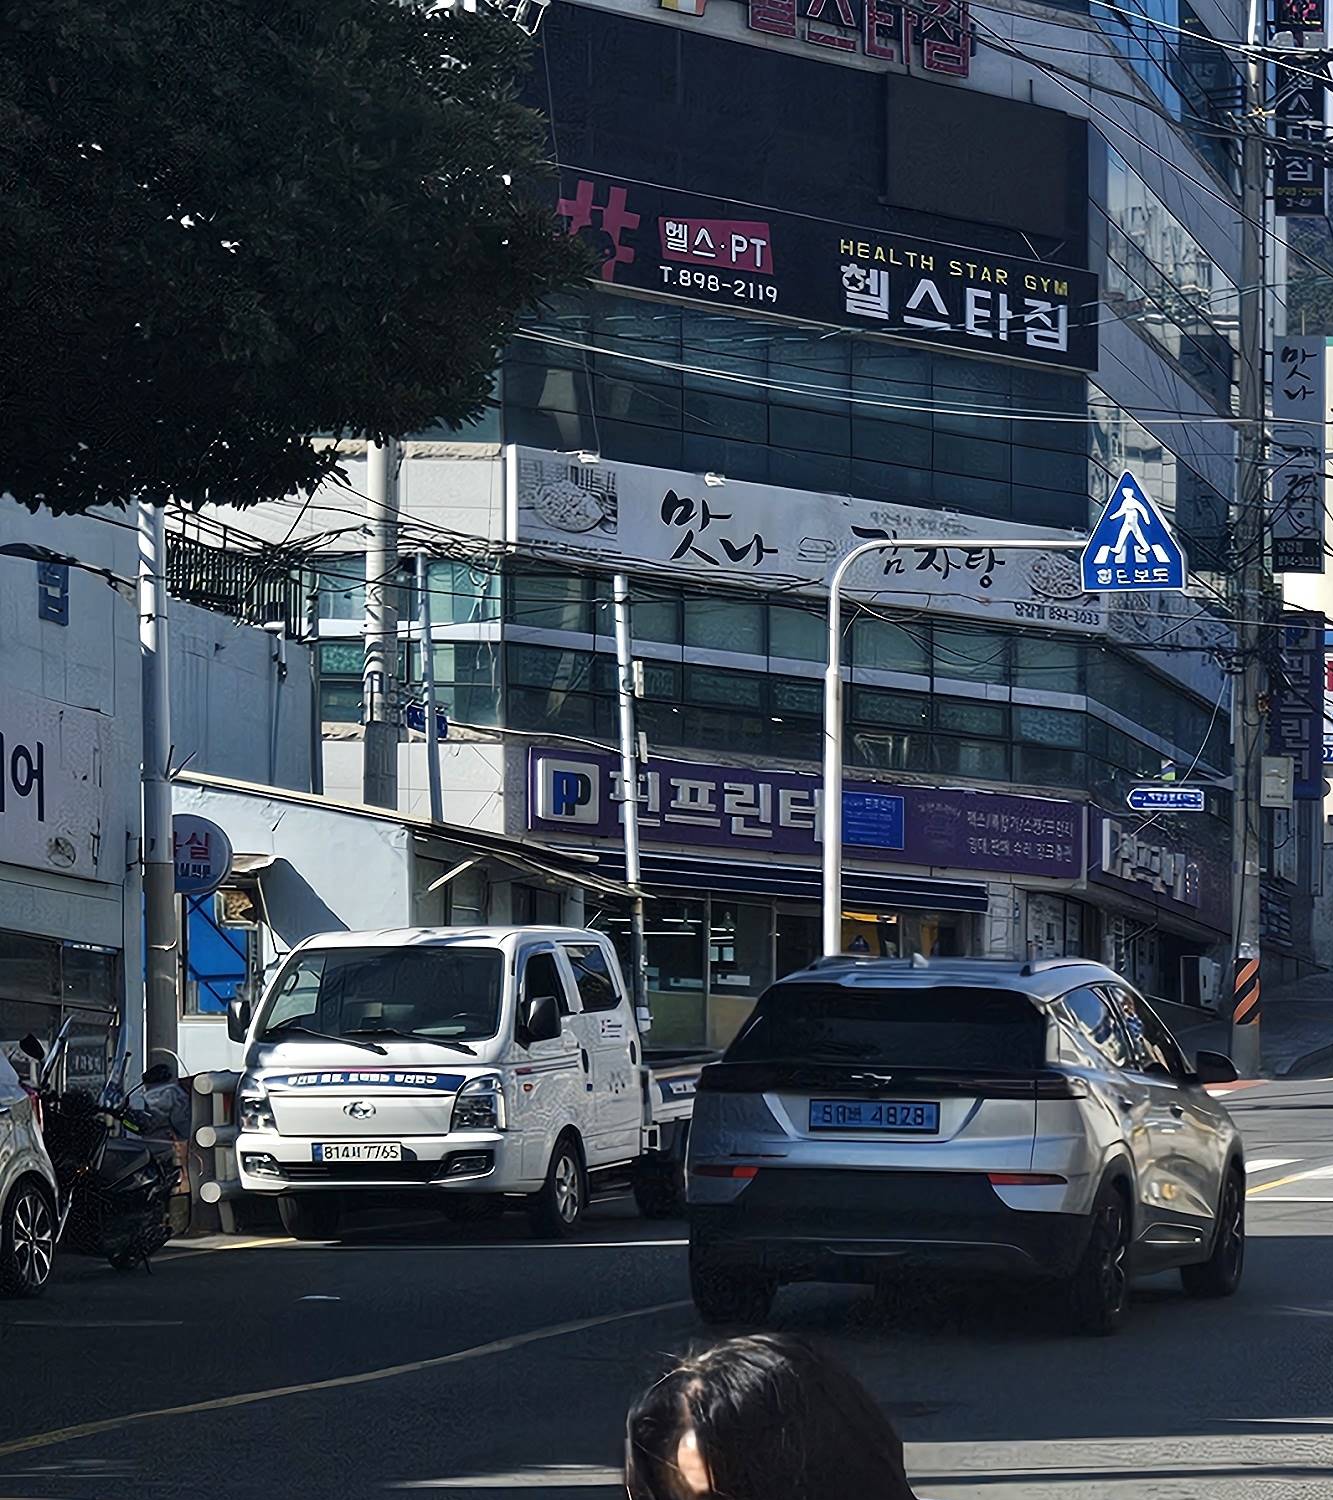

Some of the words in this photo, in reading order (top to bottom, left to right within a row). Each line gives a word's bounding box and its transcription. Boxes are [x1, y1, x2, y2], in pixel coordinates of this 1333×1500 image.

[659, 265, 778, 303] T.898-2119
[840, 239, 934, 271] HEALTH
[949, 260, 1008, 286] STAR
[1024, 274, 1068, 297] GYM
[840, 263, 1068, 352] 헬스타짐
[661, 489, 778, 567] 맛나
[0, 731, 45, 822] 어
